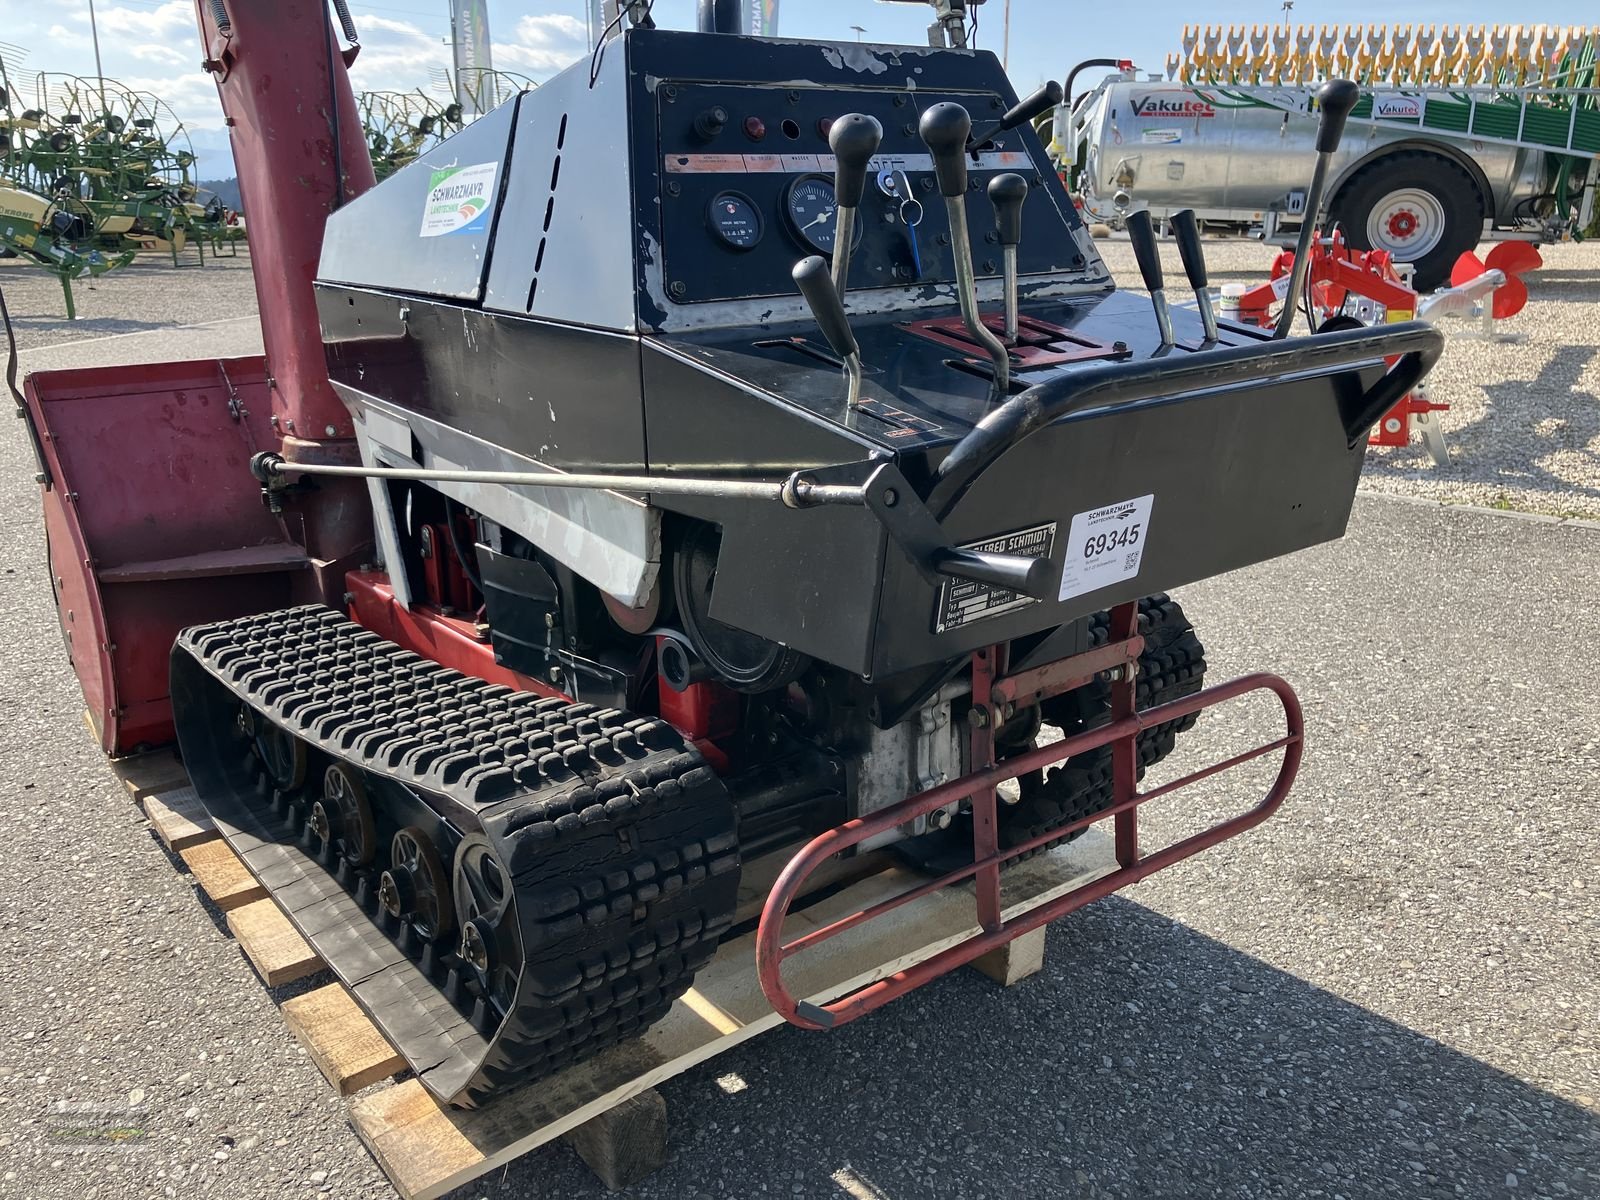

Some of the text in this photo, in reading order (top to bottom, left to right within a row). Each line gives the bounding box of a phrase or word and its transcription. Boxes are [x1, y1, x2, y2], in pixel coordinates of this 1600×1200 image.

[1130, 96, 1215, 116] Vakutec
[1378, 103, 1418, 115] Vakutec
[432, 182, 484, 202] SCHWARZMAYR
[4, 209, 35, 219] KRONE
[1088, 502, 1134, 520] SCHWARZMAYR
[1087, 515, 1116, 526] LANDTECHNIK
[974, 529, 1048, 553] FRED SCHMIDT
[1084, 523, 1141, 558] 69345
[948, 603, 957, 611] Typ
[989, 596, 1011, 607] Gewicht
